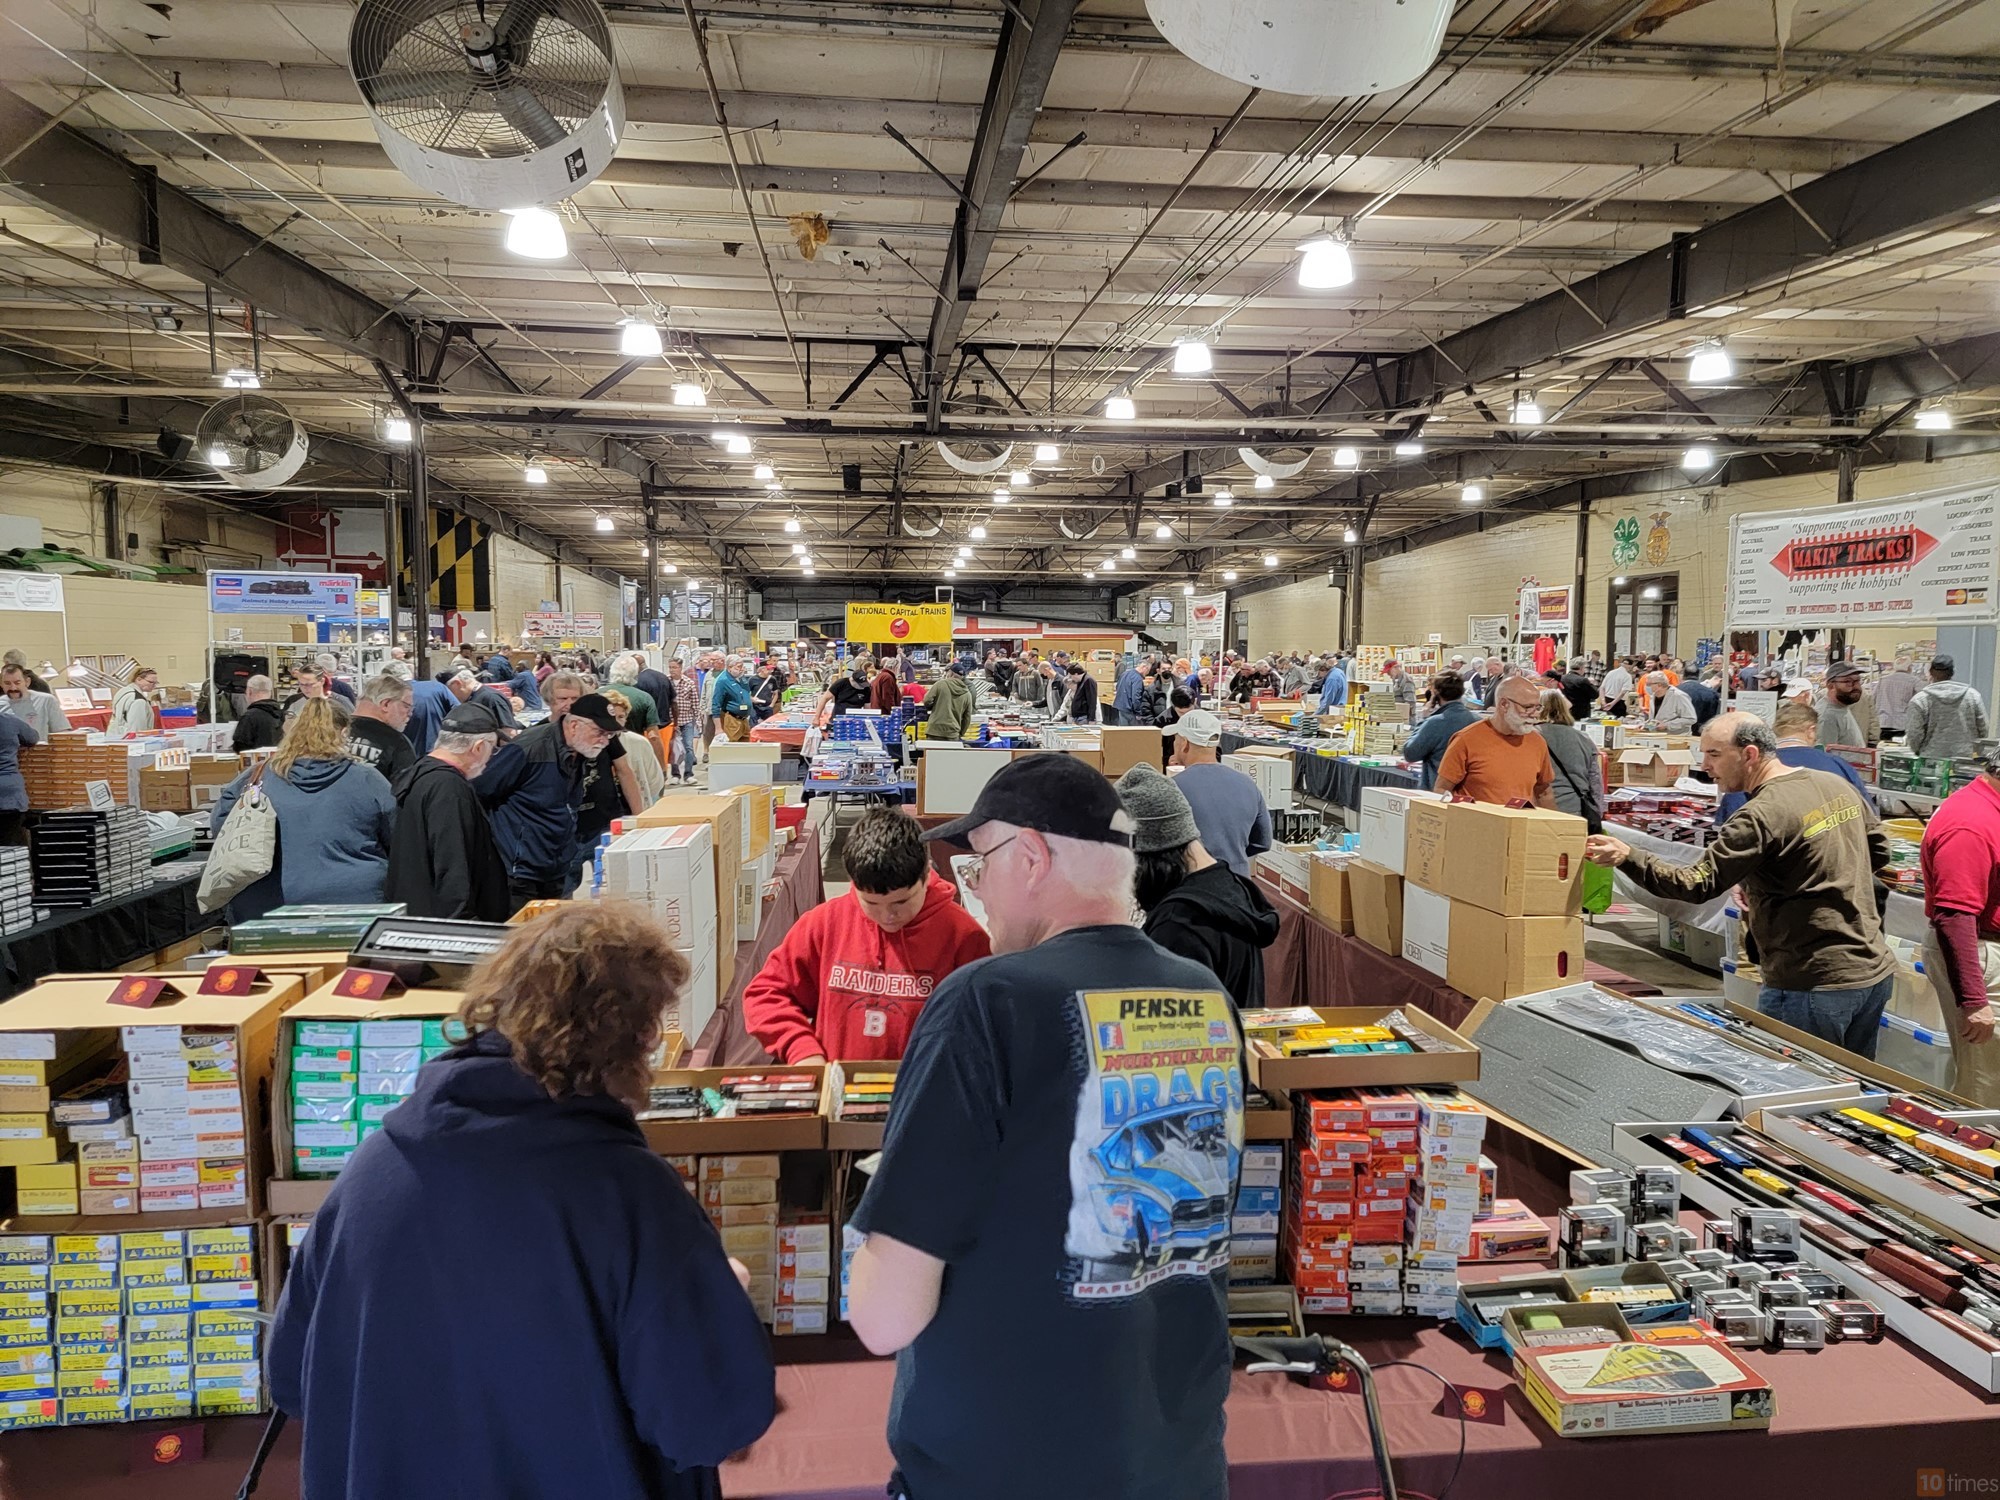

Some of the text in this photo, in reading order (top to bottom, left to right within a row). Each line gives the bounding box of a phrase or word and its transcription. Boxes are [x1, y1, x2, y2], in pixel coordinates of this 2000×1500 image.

[1903, 509, 1917, 523] by
[1969, 534, 1992, 543] TRACK
[1794, 537, 1912, 568] MAKIN' TRACKS!
[1951, 548, 1991, 559] LOW PRICES
[1937, 561, 1990, 573] EXPERT ADVICE
[1789, 573, 1910, 596] supporting the hobbyist"
[1961, 575, 1990, 584] SERVICE
[852, 606, 947, 617] NATIONAL CAPITAL TRAINS
[828, 966, 934, 997] RAIDERS
[1119, 998, 1205, 1020] PENSKE
[863, 1009, 887, 1037] B
[1102, 1047, 1236, 1073] NORTHEAST
[1100, 1064, 1243, 1130] DRAGS
[143, 1246, 182, 1257] AHM
[210, 1242, 250, 1253] AHM
[212, 1269, 252, 1280] AHM
[5, 1281, 46, 1290] AHM
[72, 1278, 112, 1288] AHM
[79, 1303, 120, 1313] AHM
[149, 1300, 189, 1310] AHM
[6, 1307, 46, 1317] AHM
[215, 1322, 255, 1333] AHM
[6, 1334, 47, 1344] AHM
[60, 1344, 101, 1355] AHM
[213, 1351, 253, 1361] AHM
[218, 1403, 258, 1413] AHM
[14, 1415, 57, 1426] AHM
[85, 1409, 126, 1421] AHM
